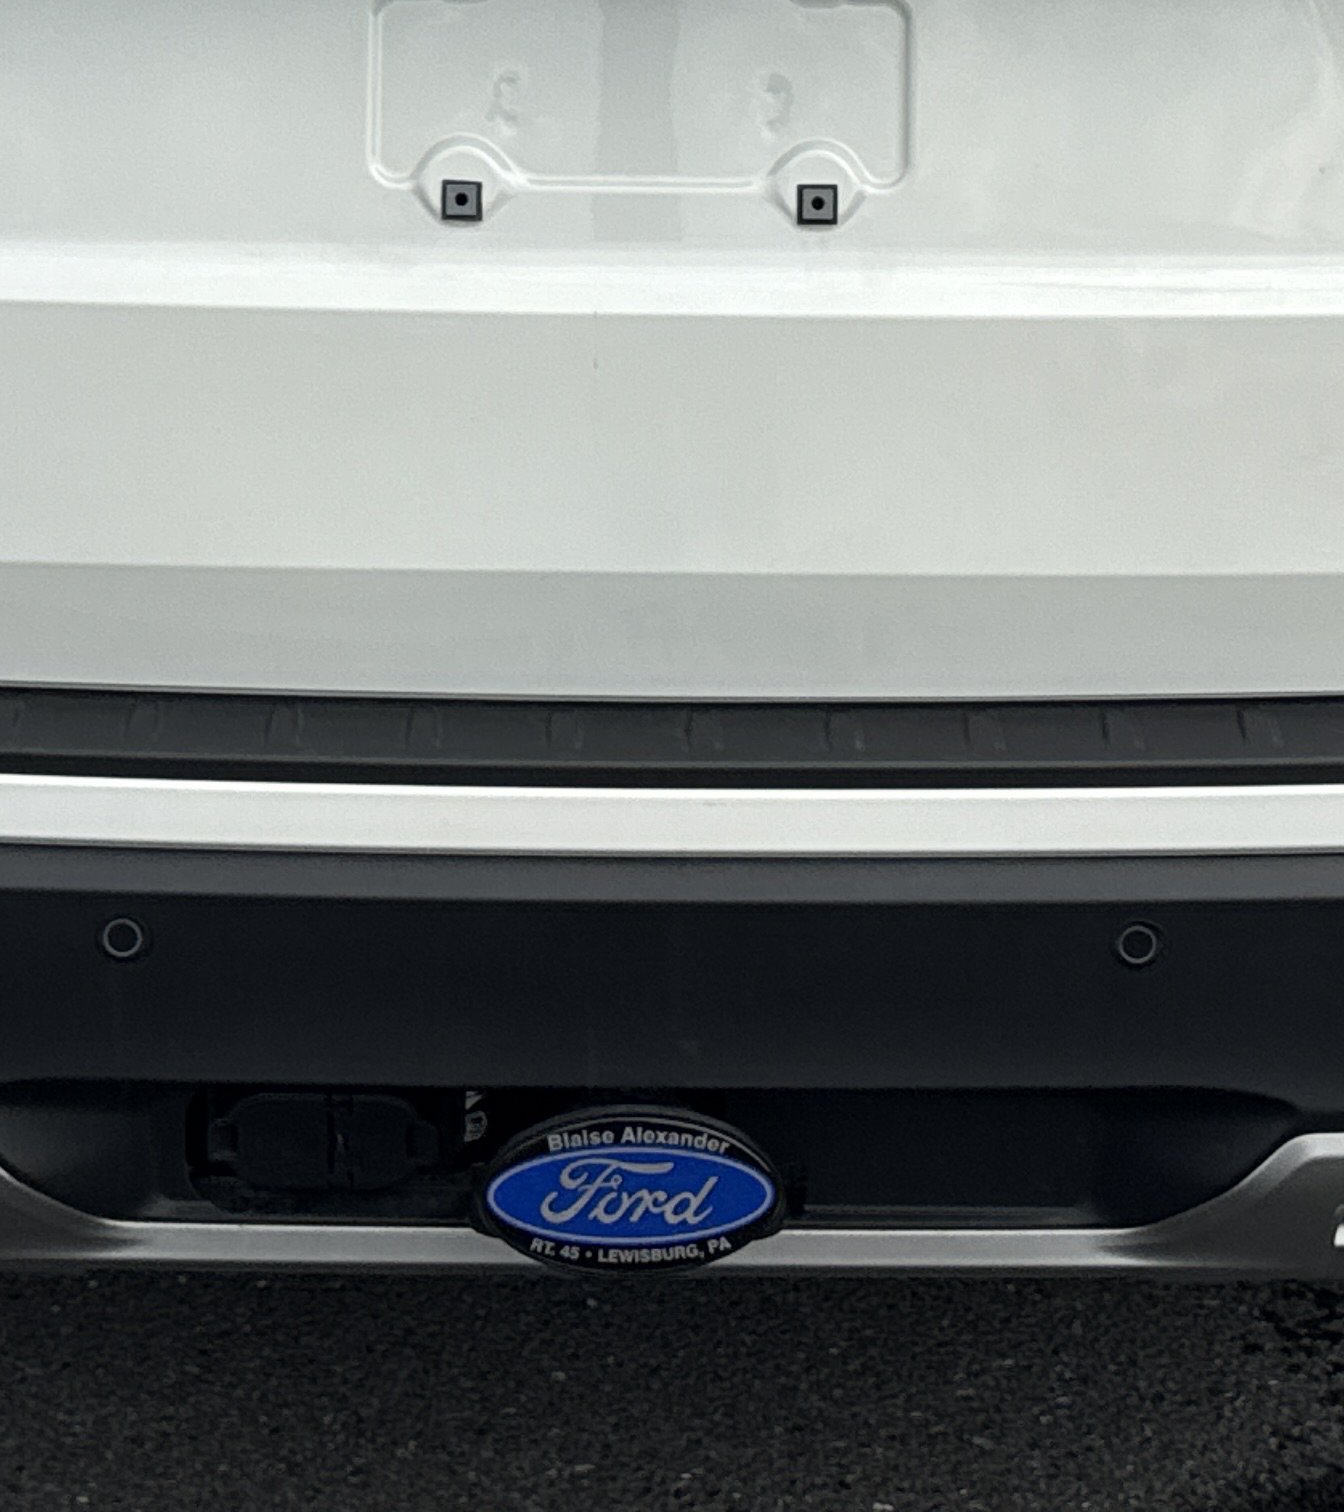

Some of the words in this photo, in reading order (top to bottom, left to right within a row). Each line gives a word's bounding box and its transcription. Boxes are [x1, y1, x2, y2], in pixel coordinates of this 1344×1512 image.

[547, 1128, 615, 1152] Blaise
[621, 1125, 730, 1155] Alexander
[540, 1157, 719, 1224] Ford
[560, 1244, 581, 1260] 45
[597, 1242, 705, 1263] LEWISBURG,
[707, 1236, 733, 1254] PA
